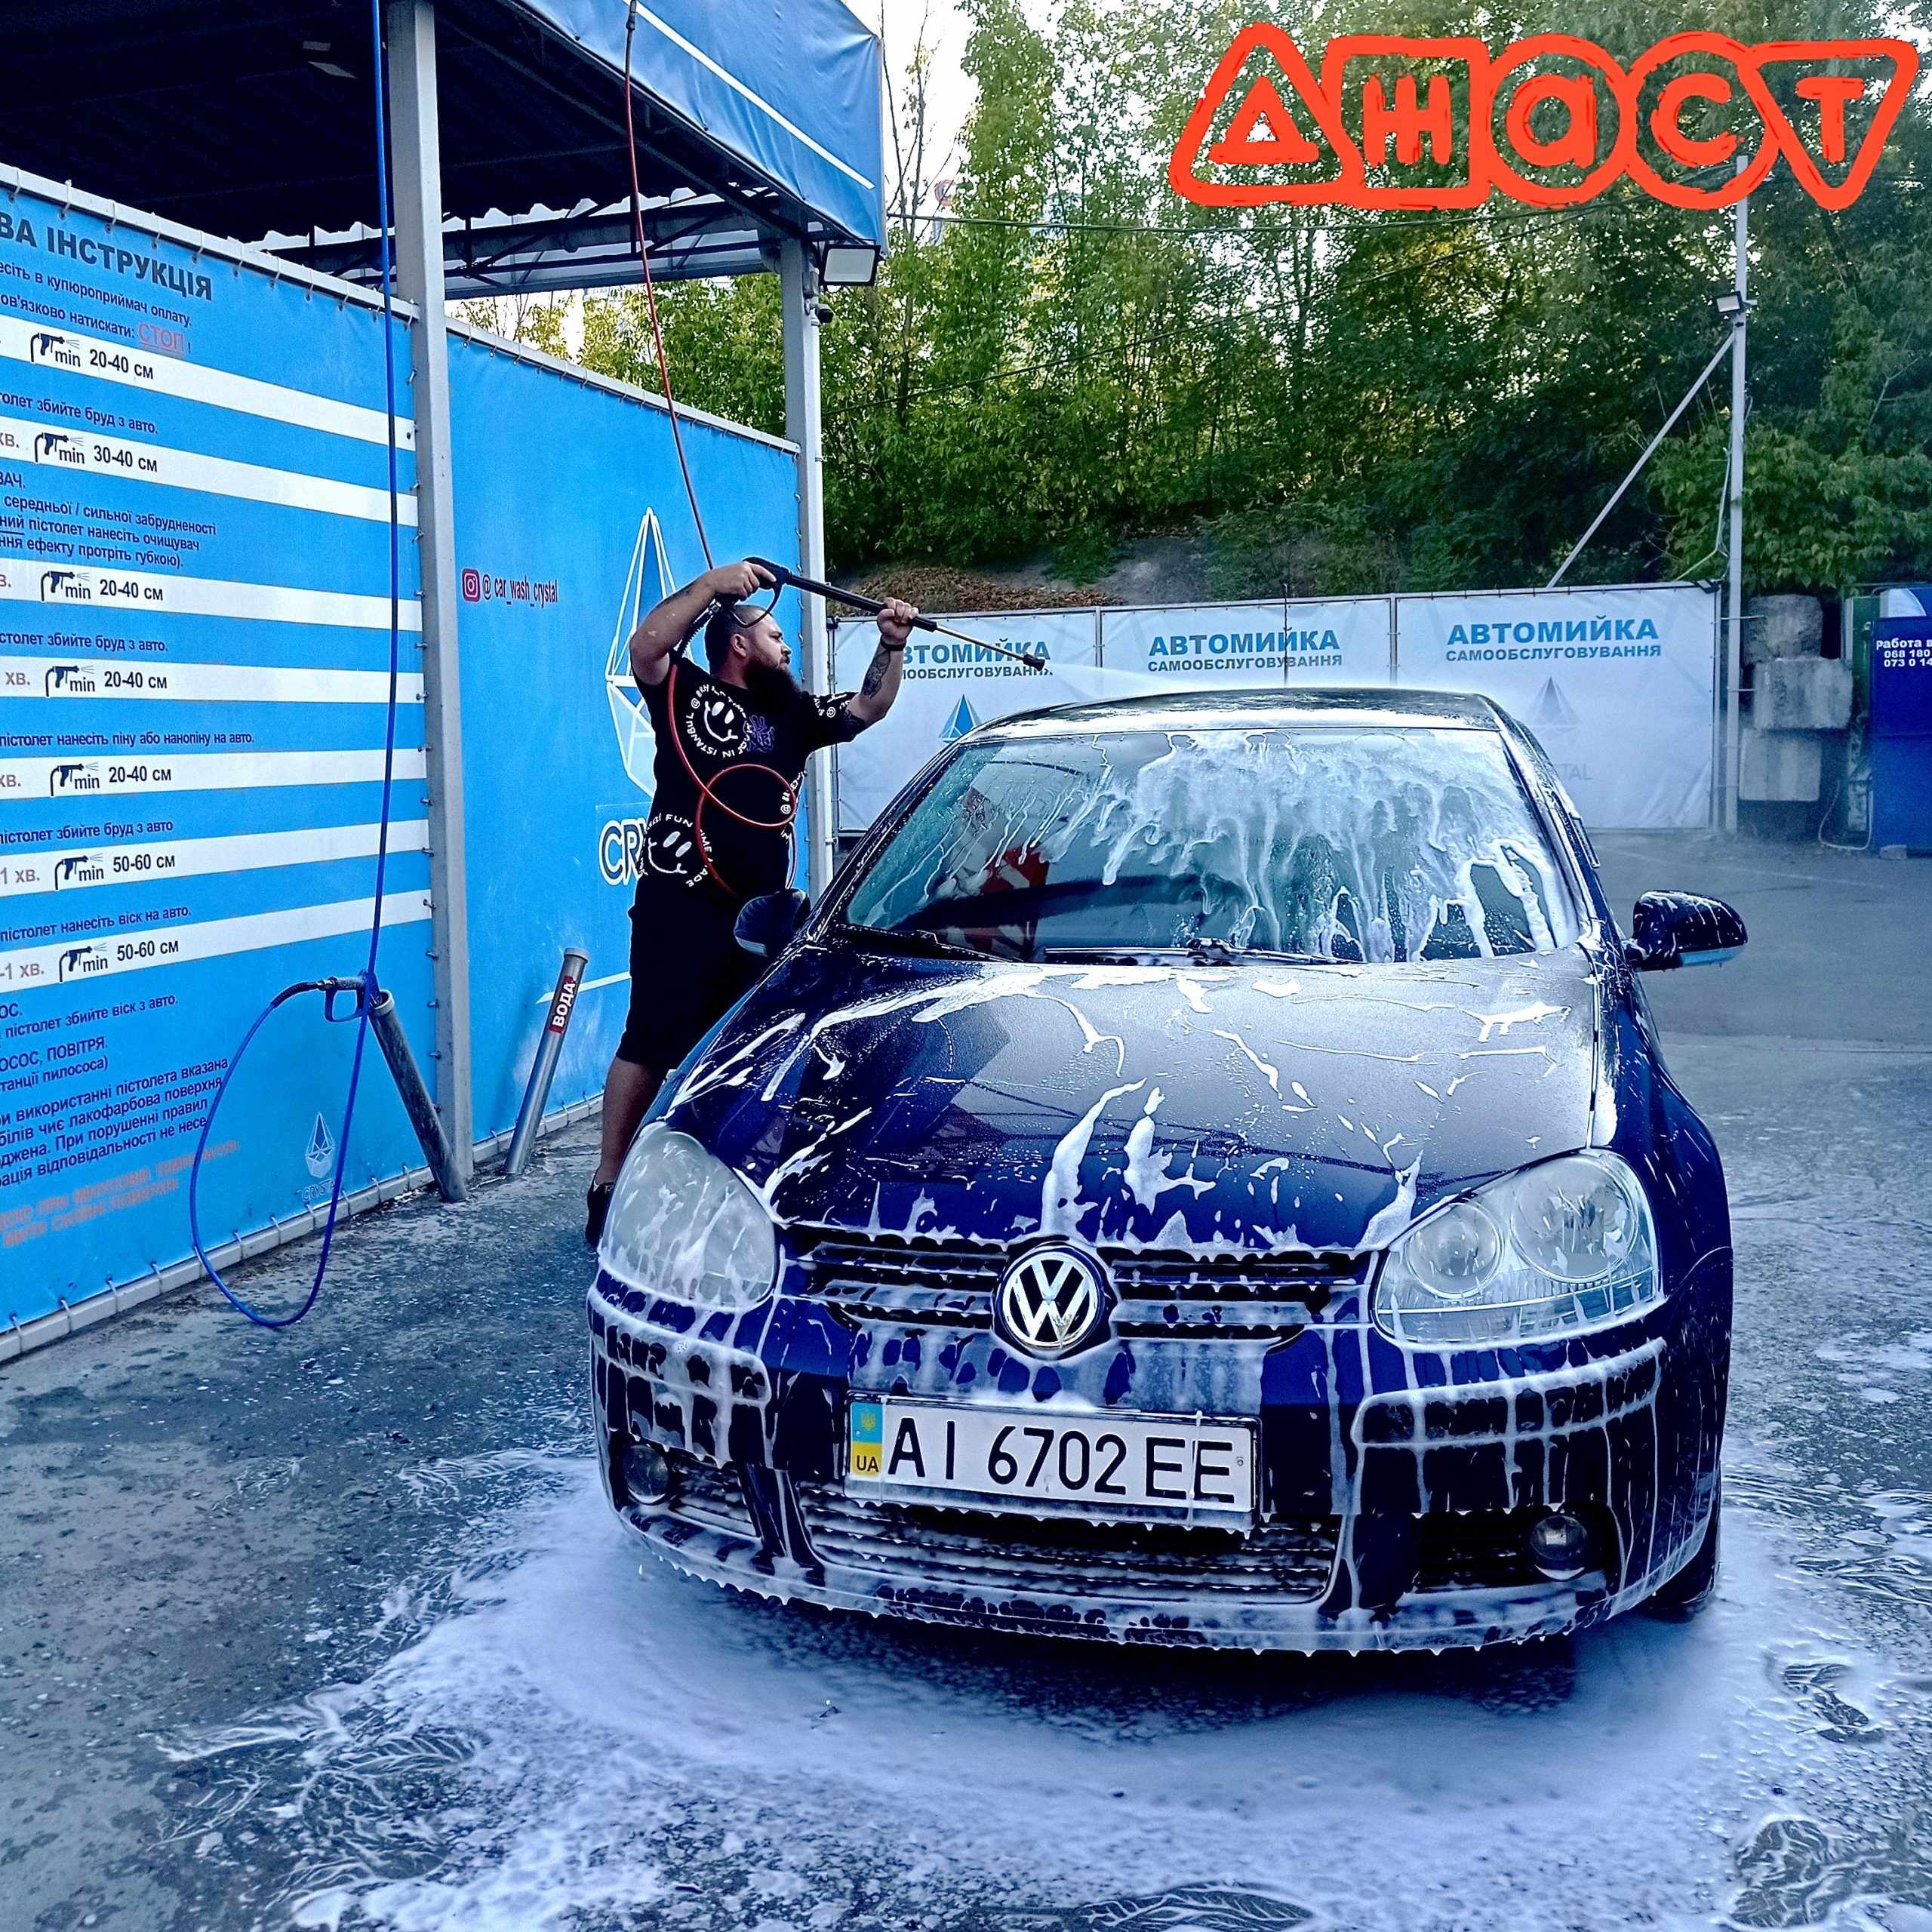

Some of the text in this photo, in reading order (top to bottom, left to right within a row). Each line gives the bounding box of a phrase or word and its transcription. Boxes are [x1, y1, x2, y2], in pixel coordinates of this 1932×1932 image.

[47, 226, 212, 301] ІНСТРУКЦІЯ
[35, 272, 43, 284] в
[47, 275, 147, 314] купюроприймач
[151, 305, 192, 327] оплату.
[70, 312, 135, 339] натискати:
[139, 322, 184, 352] СТОП
[55, 349, 153, 380] min 20-40 см
[37, 398, 82, 418] збийте
[85, 407, 115, 426] бруд
[118, 416, 125, 427] з
[128, 418, 158, 435] авто.
[60, 447, 85, 465] min
[94, 445, 133, 468] 30-40
[138, 457, 157, 472] см
[5, 495, 72, 515] середньої
[84, 505, 131, 523] сильної
[136, 513, 217, 536] забрудненості
[29, 517, 83, 537] пістолет
[88, 526, 140, 543] нанесіть
[143, 534, 199, 552] очищувач
[27, 537, 74, 558] ефекту
[78, 543, 131, 562] протріть
[135, 551, 183, 568] губкою).
[65, 582, 91, 600] min
[100, 579, 139, 598] 20-40
[144, 587, 163, 601] см
[48, 632, 91, 648] збийте
[96, 635, 125, 651] бруд
[129, 640, 135, 650] з
[139, 641, 168, 652] авто.
[1149, 628, 1340, 657] АВТОМИЙКА
[1447, 615, 1660, 645] АВТОМИЙКА
[1876, 638, 1922, 651] работа
[903, 638, 1051, 665] ВТОМИЙКА
[1148, 654, 1343, 672] САМООБСЛУГОВУВАННЯ
[1446, 645, 1662, 662] САМООБСЛУГОВУВАННЯ
[1884, 659, 1906, 667] 073
[1909, 658, 1916, 666] 0
[69, 676, 95, 692] min
[104, 671, 143, 688] 20-40
[148, 676, 168, 689] см
[57, 731, 108, 746] нанесіть
[112, 731, 136, 748] піну
[140, 731, 160, 745] або
[164, 731, 211, 747] нанопіну
[214, 734, 226, 743] на
[229, 734, 254, 743] авто.
[75, 771, 100, 789] min
[109, 766, 147, 783] 20-40
[152, 768, 171, 780] см
[57, 823, 100, 840] збийте
[105, 822, 133, 837] бруд
[137, 823, 143, 833] з
[147, 820, 173, 832] авто
[666, 814, 693, 828] FUN
[598, 817, 648, 886] CR
[78, 865, 104, 882] min
[113, 854, 151, 872] 50-60
[156, 854, 175, 869] см
[1, 906, 191, 943] пістолет нанесіть віск на авто.
[82, 954, 108, 972] min
[117, 940, 155, 961] 50-60
[160, 940, 179, 955] см
[5, 994, 178, 1038] пістолет збийте віск з авто.
[552, 982, 576, 1027] ВОДА
[43, 1055, 108, 1083] пилососа)
[16, 1084, 112, 1122] використанні
[116, 1070, 177, 1096] пістолета
[181, 1057, 228, 1080] вказана
[38, 1119, 65, 1134] чиє
[69, 1093, 161, 1128] лакофарбова
[165, 1076, 222, 1103] поверхня
[55, 1133, 83, 1152] При
[88, 1109, 158, 1141] порушенні
[163, 1098, 208, 1121] правил
[37, 1128, 155, 1176] відповідальності
[160, 1125, 174, 1139] не
[179, 1116, 207, 1135] несе
[856, 1417, 1235, 1504] UA AI 6702 EE
